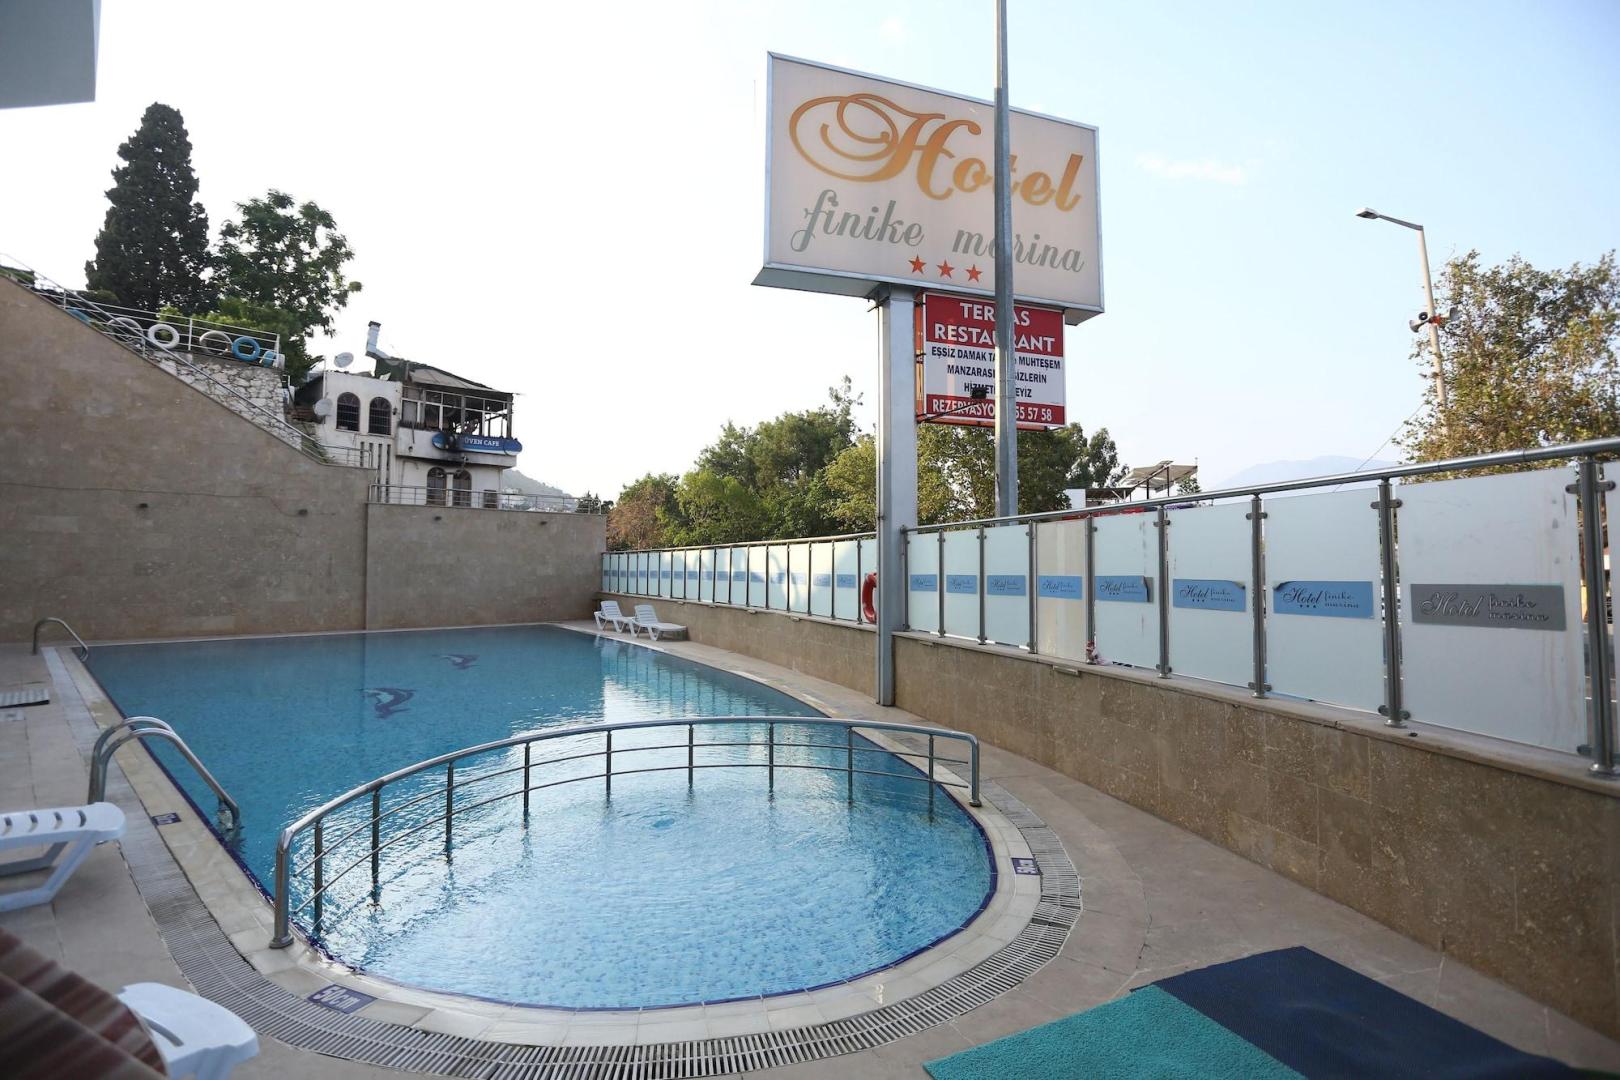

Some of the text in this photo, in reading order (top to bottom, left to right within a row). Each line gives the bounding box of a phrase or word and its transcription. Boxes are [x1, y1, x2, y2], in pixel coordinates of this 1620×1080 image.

[790, 189, 925, 253] finike
[957, 349, 987, 361] DAMAK
[1027, 407, 1038, 420] 57
[1041, 408, 1052, 422] 58
[483, 439, 499, 447] CAFE
[1180, 585, 1210, 599] Hotel
[1282, 588, 1323, 604] Hotel
[1421, 592, 1484, 616] Hotel
